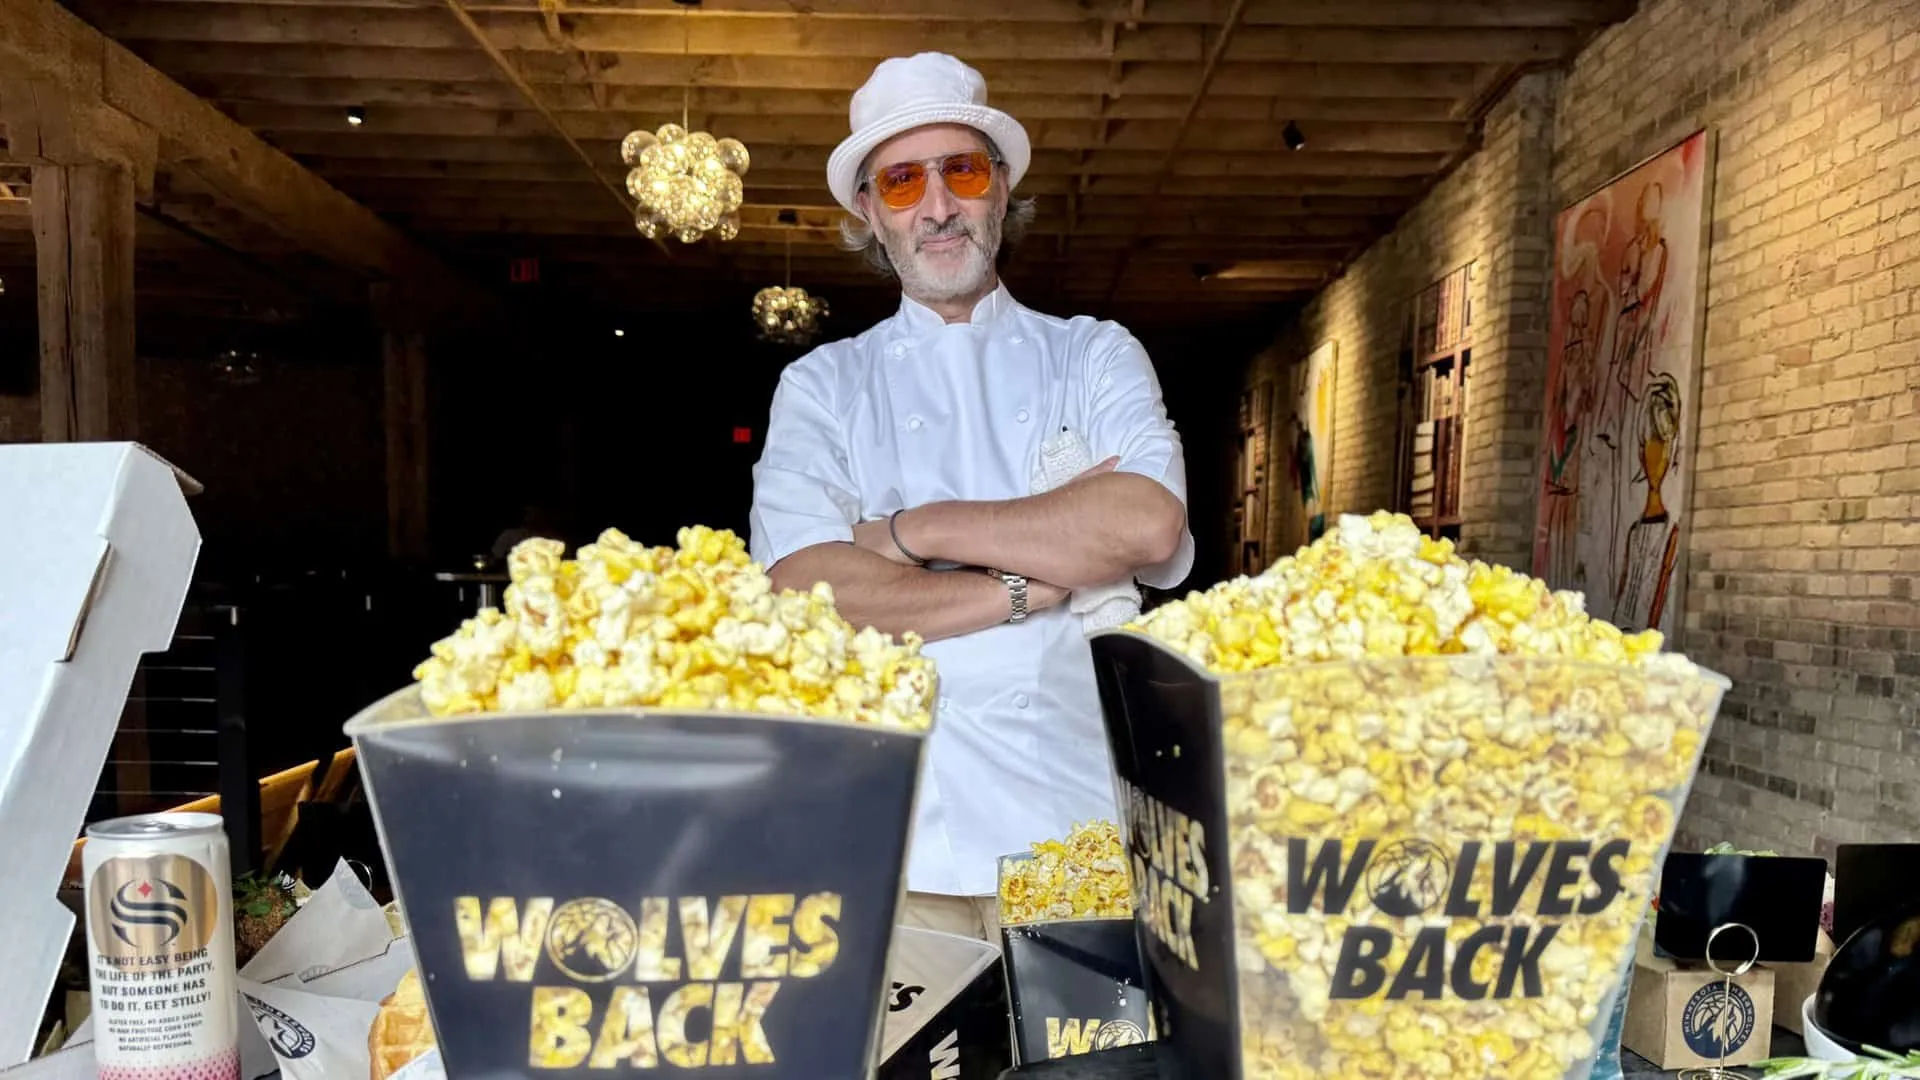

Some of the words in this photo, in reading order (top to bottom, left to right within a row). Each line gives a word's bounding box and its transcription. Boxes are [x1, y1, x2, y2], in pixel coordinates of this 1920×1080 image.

[1287, 838, 1631, 917] WOLVES
[113, 956, 134, 966] NOT
[139, 954, 169, 966] EASY
[174, 948, 208, 963] BEING
[453, 891, 842, 982] WOLVES
[109, 971, 129, 981] LIFE
[133, 971, 145, 981] OF
[152, 970, 174, 980] THE
[1328, 924, 1561, 1000] BACK
[102, 984, 118, 996] BUT
[122, 983, 180, 997] SOMEONE
[183, 978, 206, 991] HAS
[111, 1000, 125, 1011] DO
[145, 999, 168, 1011] GET
[171, 991, 211, 1008] STILLY!
[528, 981, 782, 1069] BACK
